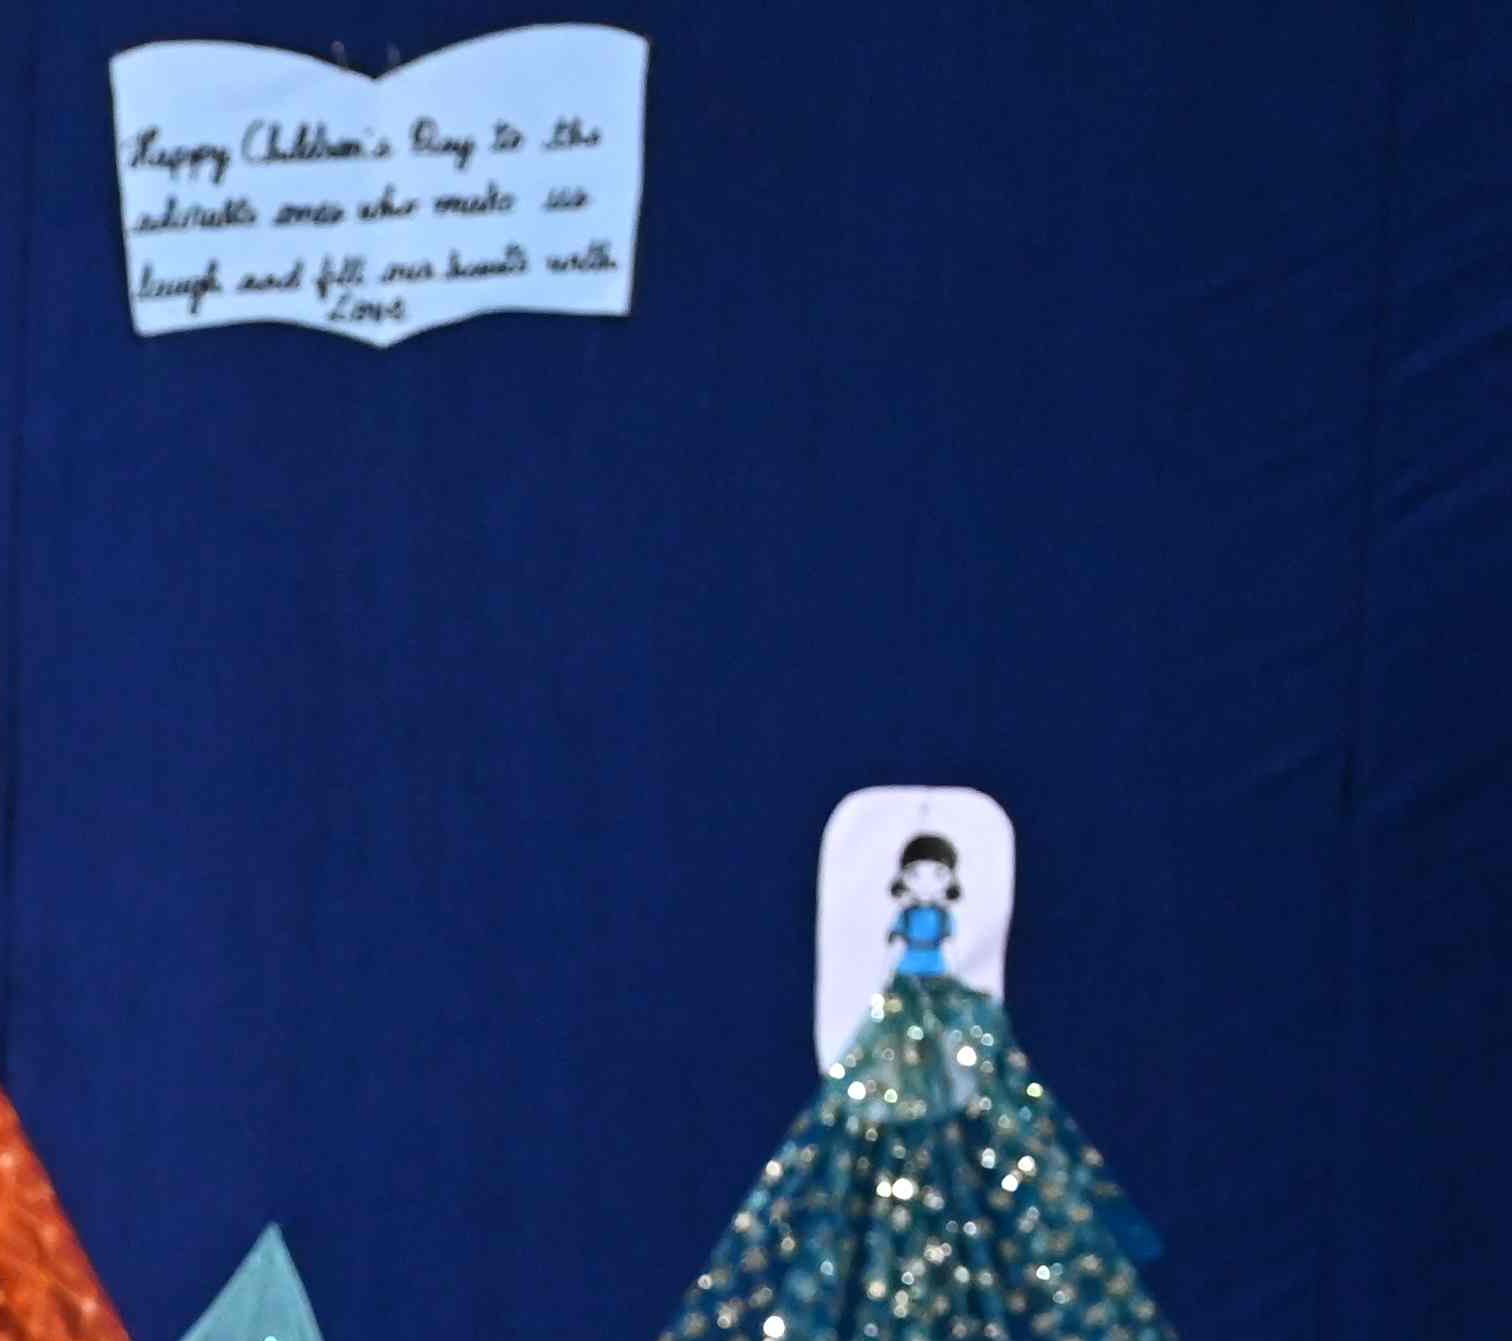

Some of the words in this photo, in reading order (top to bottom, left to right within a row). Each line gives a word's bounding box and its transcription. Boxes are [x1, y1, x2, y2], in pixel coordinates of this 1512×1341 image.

[127, 126, 233, 187] Happy
[409, 116, 477, 172] Day
[490, 121, 526, 154] to
[542, 116, 602, 152] the
[355, 184, 420, 223] who
[133, 258, 224, 319] laugh
[235, 260, 305, 294] and
[314, 256, 367, 303] fill
[545, 240, 619, 274] with
[325, 291, 406, 324] Love
